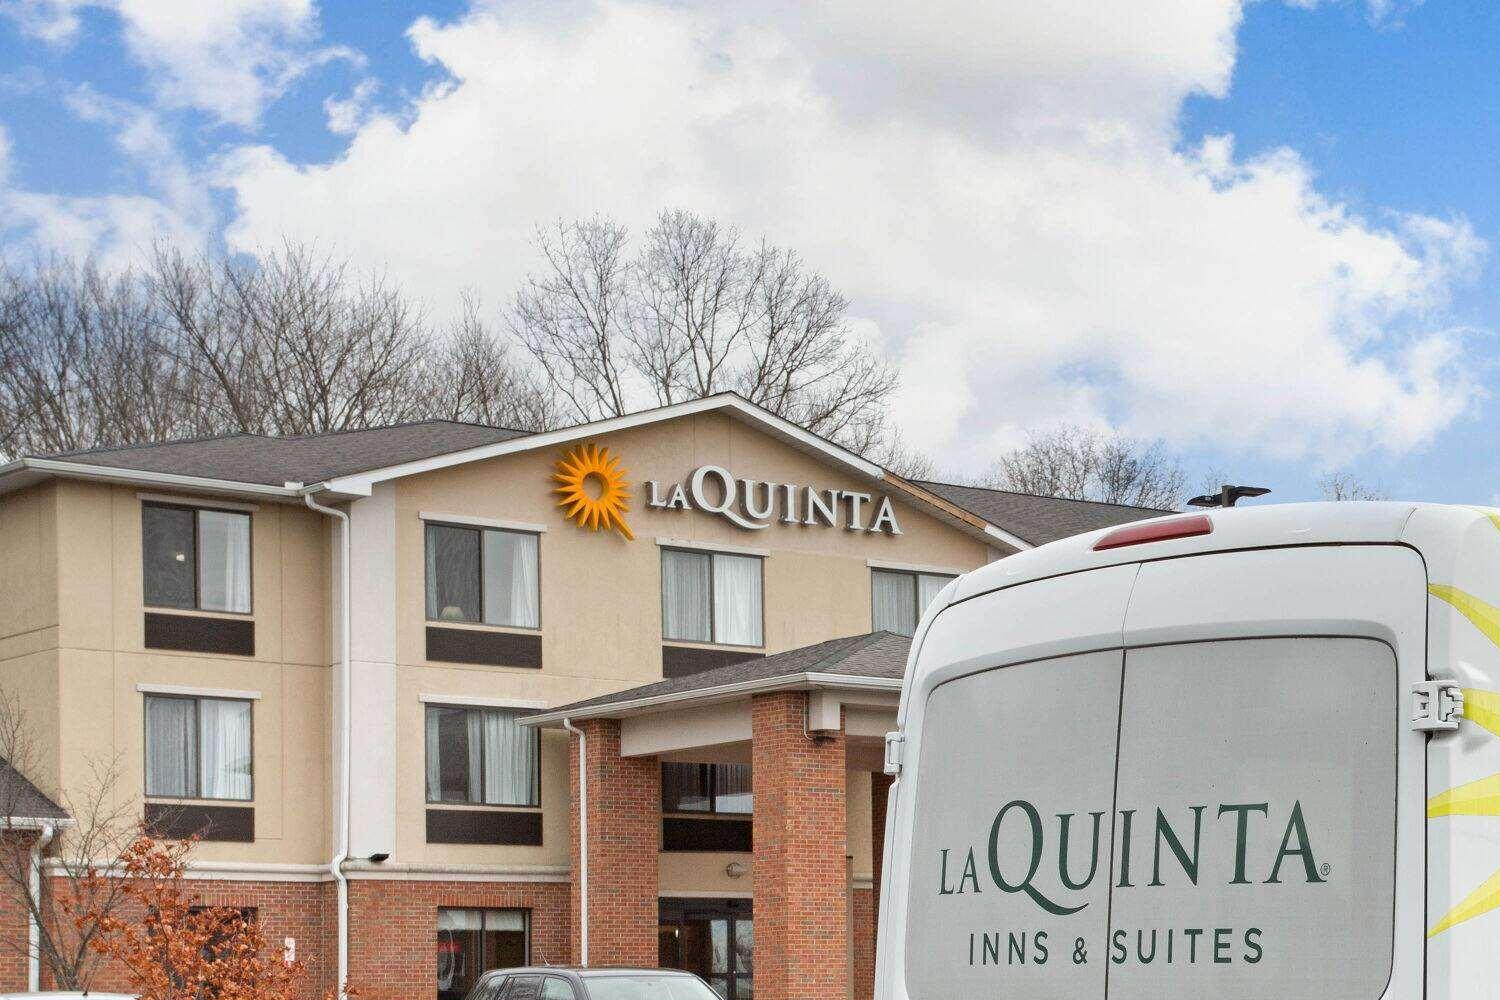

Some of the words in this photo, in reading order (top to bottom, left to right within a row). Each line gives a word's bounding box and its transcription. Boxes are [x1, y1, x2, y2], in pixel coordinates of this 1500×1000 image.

[970, 931, 1048, 965] INNS
[1072, 936, 1088, 965] &
[1111, 927, 1263, 965] SUITES
